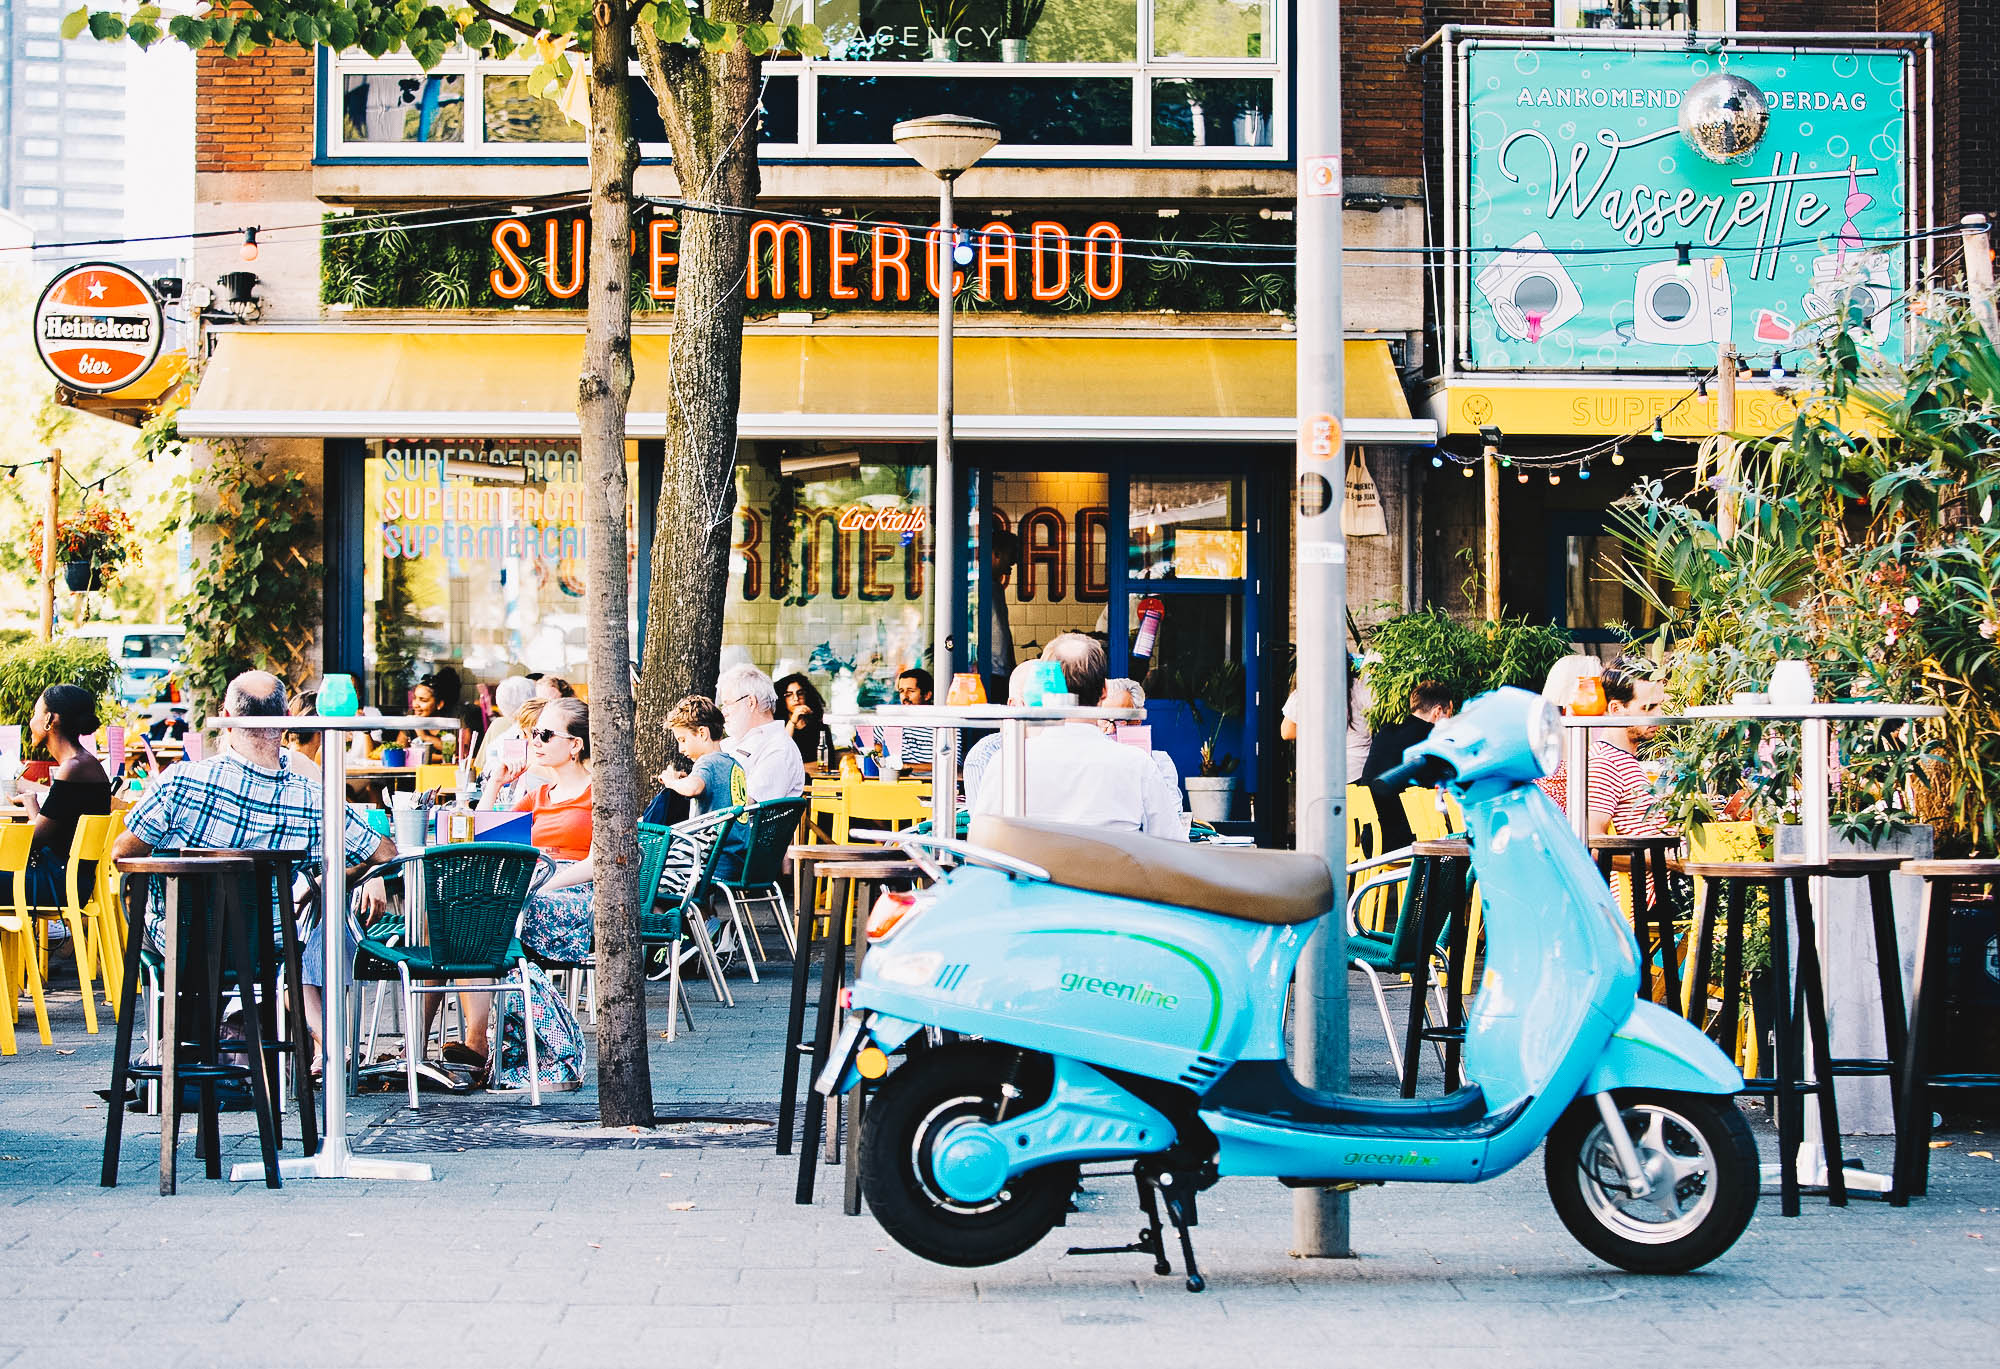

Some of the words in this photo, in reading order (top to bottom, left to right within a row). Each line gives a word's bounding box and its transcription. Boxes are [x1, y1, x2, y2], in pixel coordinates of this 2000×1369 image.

[852, 26, 999, 47] AGENCY
[1516, 87, 1684, 108] AANKOMEND
[1766, 91, 1868, 112] DERDAG
[1498, 127, 1878, 280] Wasserette
[490, 219, 1122, 300] SUEMERCADO
[45, 316, 149, 340] Heineken
[78, 353, 112, 375] bier
[1572, 396, 1690, 427] SUPER
[383, 487, 584, 521] SUPERMERCA
[837, 504, 927, 532] Cocktails
[382, 525, 586, 560] SUPERMERCA
[1060, 972, 1179, 1011] greenline
[1343, 1150, 1440, 1168] greenline
